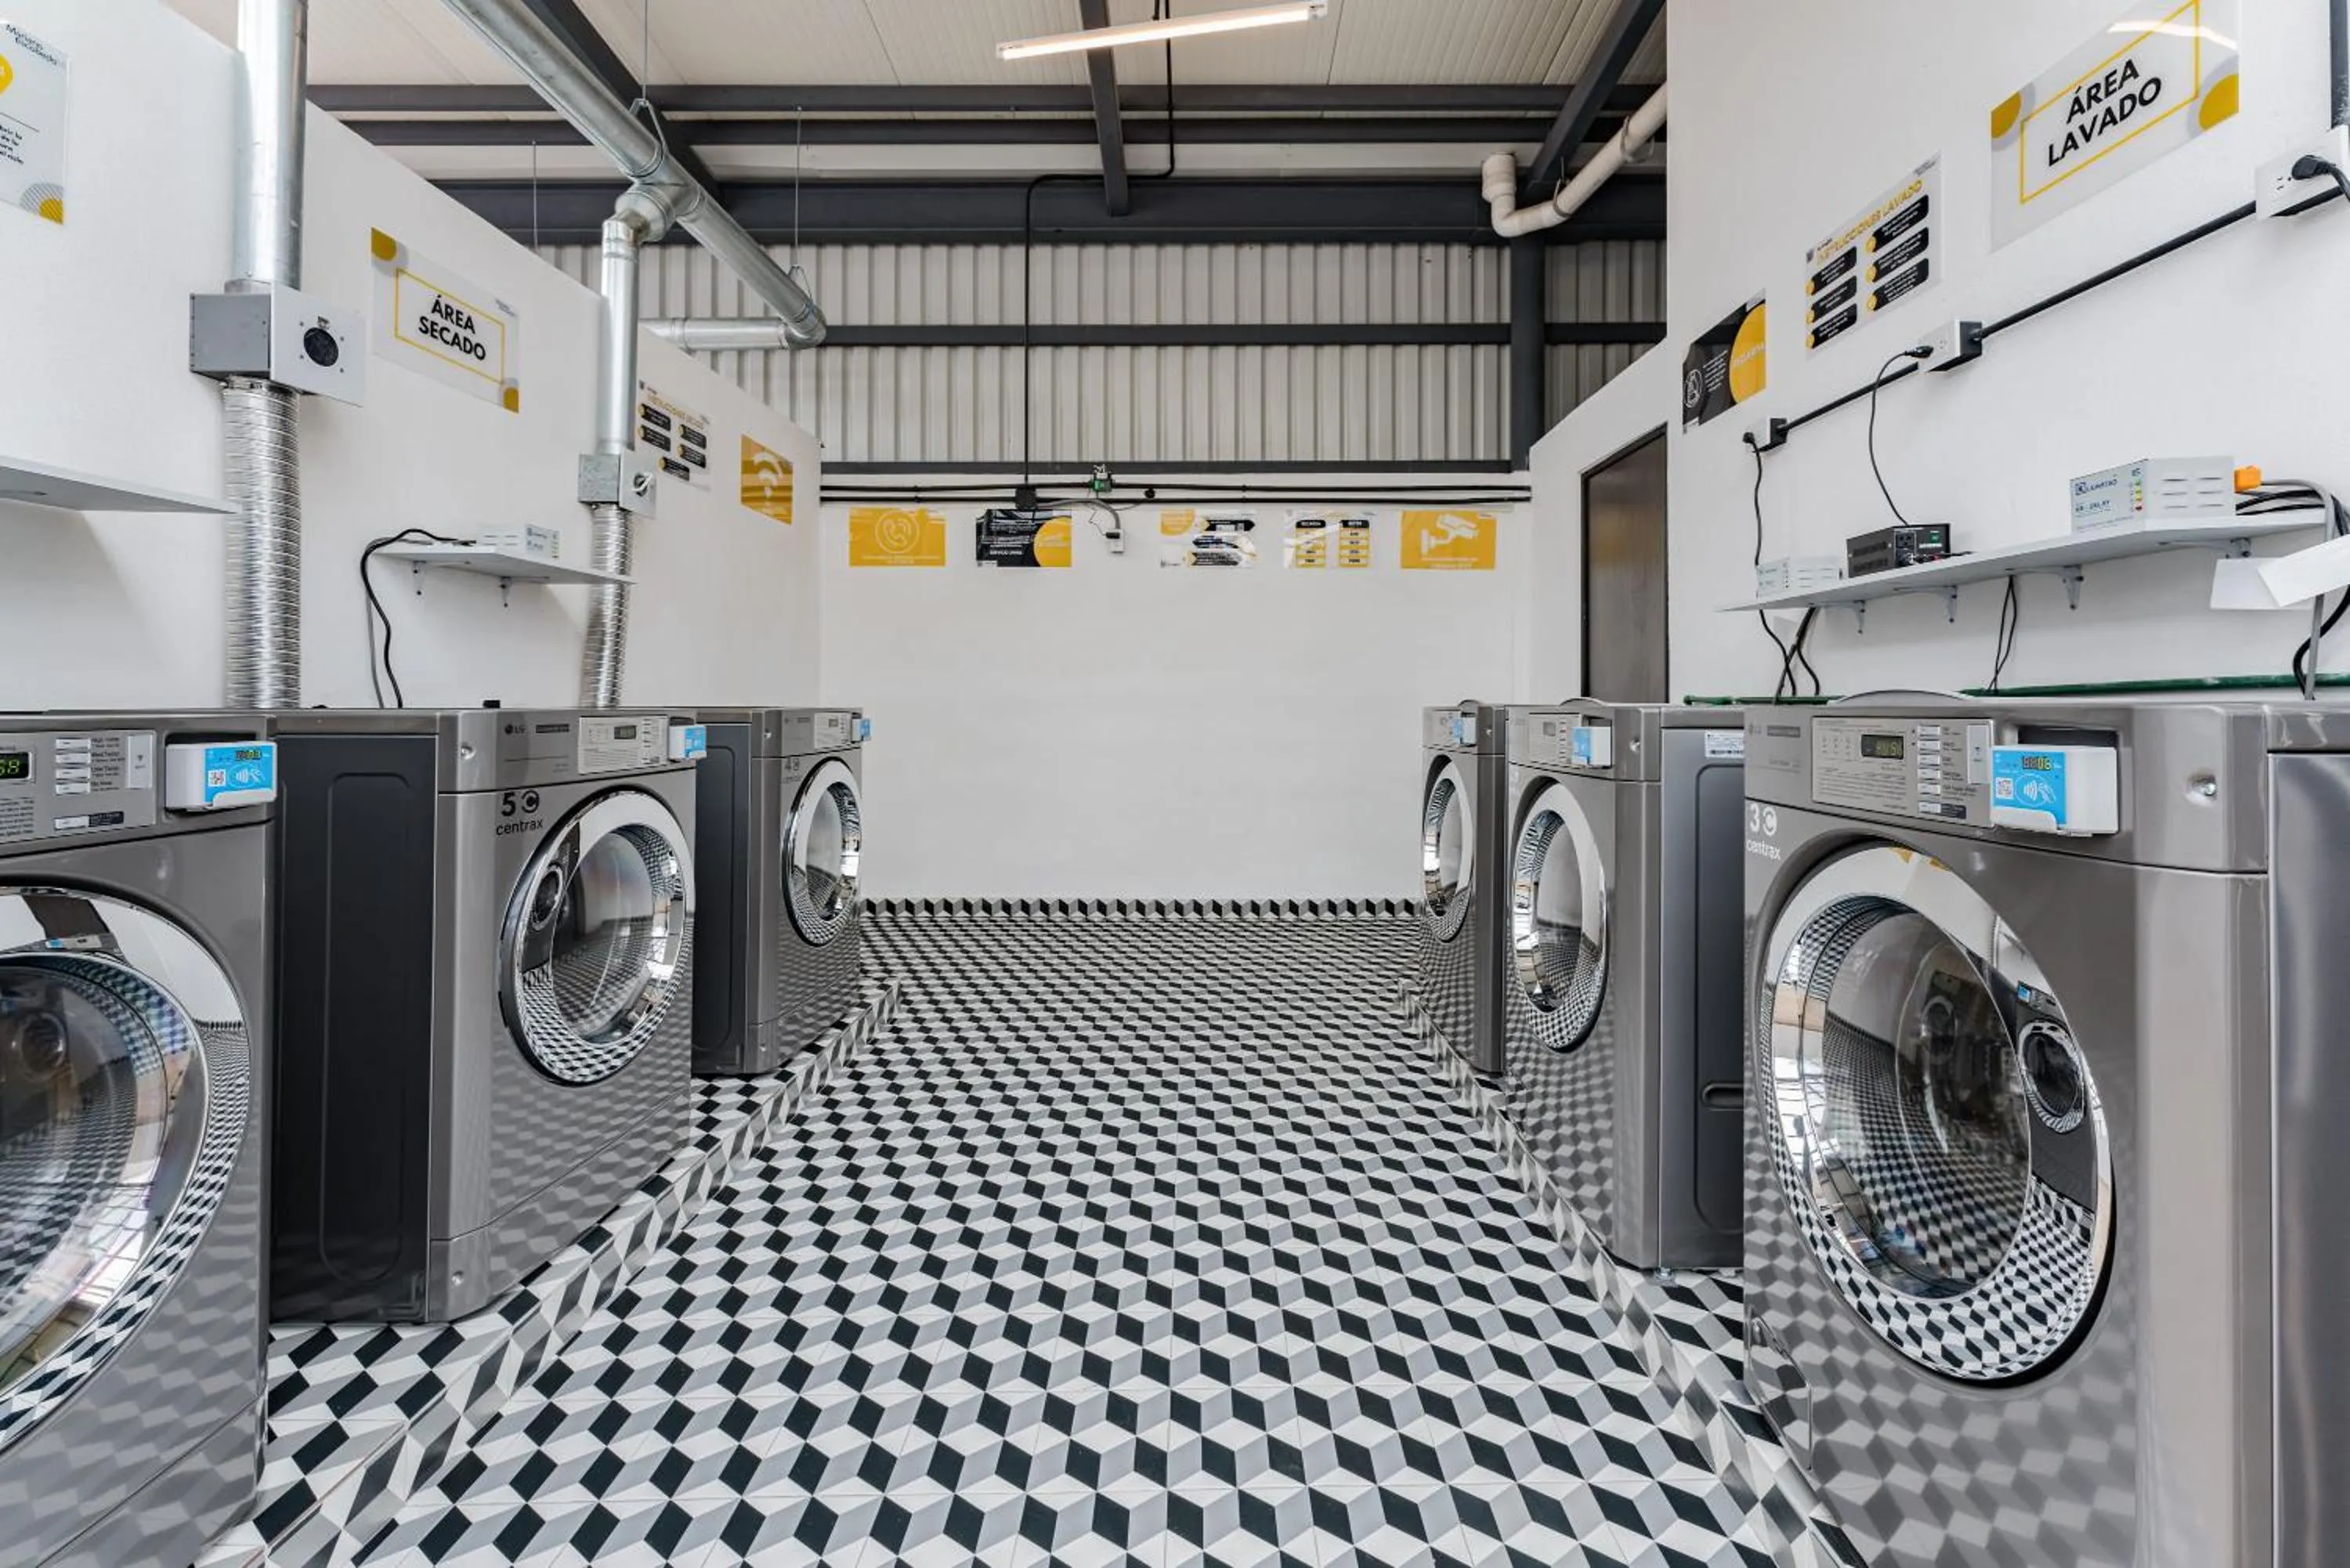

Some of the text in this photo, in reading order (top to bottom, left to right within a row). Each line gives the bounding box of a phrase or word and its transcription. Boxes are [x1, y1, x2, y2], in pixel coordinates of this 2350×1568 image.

[2066, 58, 2140, 125] ÁREA
[2048, 77, 2162, 167] LAVADO
[431, 294, 476, 335] ÁREA
[418, 316, 486, 361] SECADO
[496, 818, 544, 836] centrax
